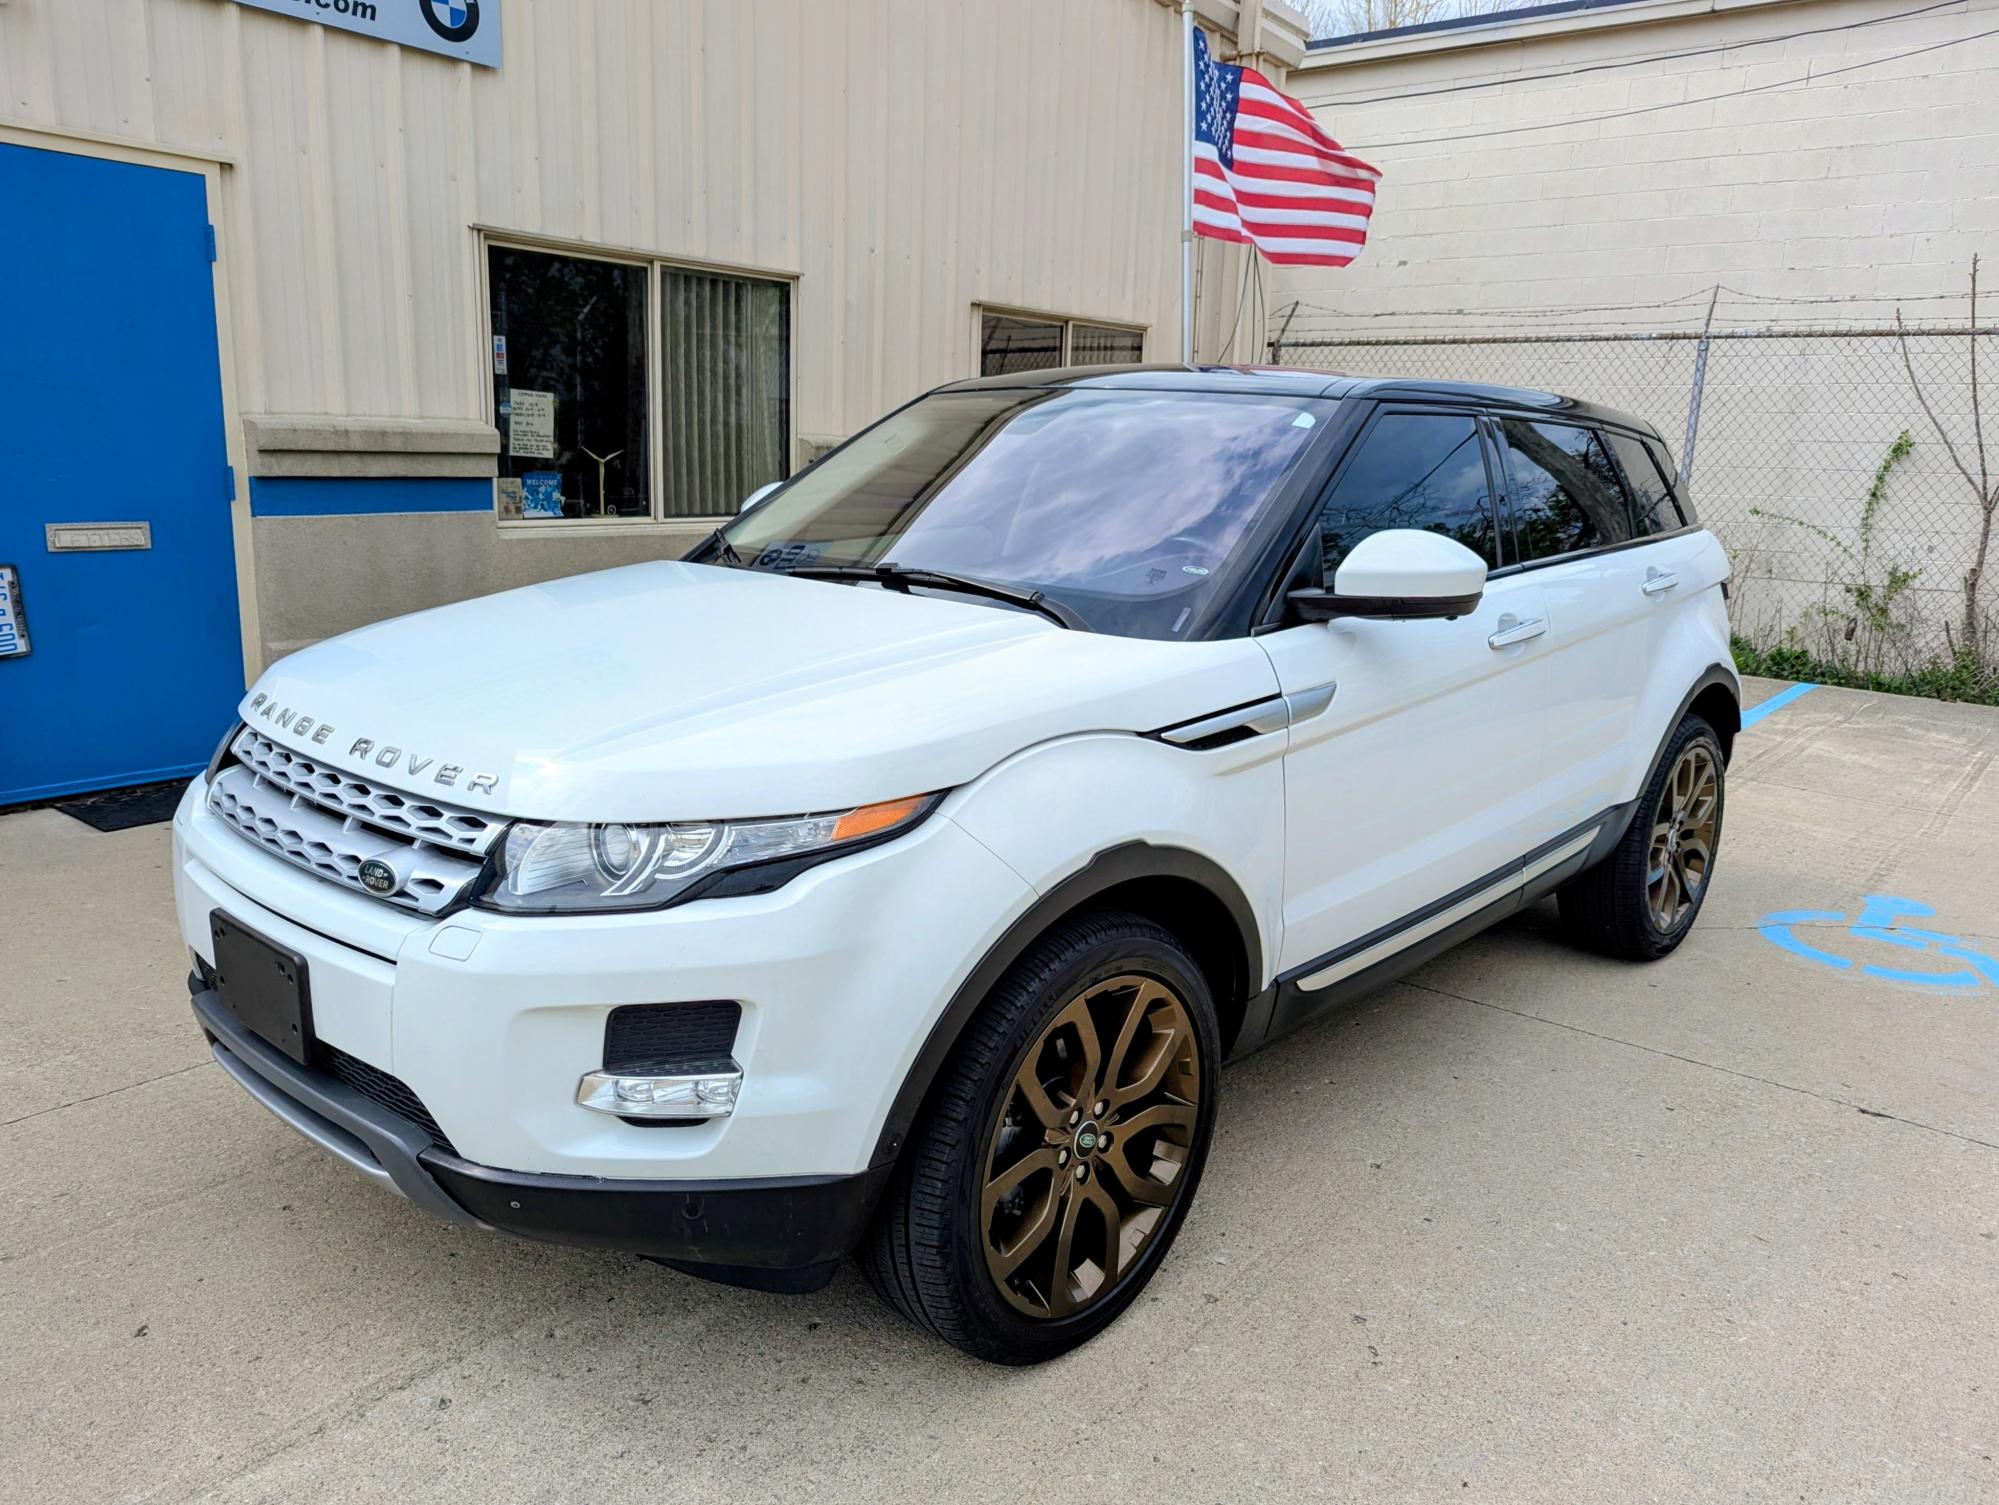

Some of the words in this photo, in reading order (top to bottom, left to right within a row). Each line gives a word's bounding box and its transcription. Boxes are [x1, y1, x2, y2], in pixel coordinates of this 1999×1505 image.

[291, 0, 377, 21] .com
[250, 692, 335, 745] RANGE
[349, 737, 499, 796] ROVER
[364, 865, 384, 877] LAND
[365, 876, 388, 889] ROVER
